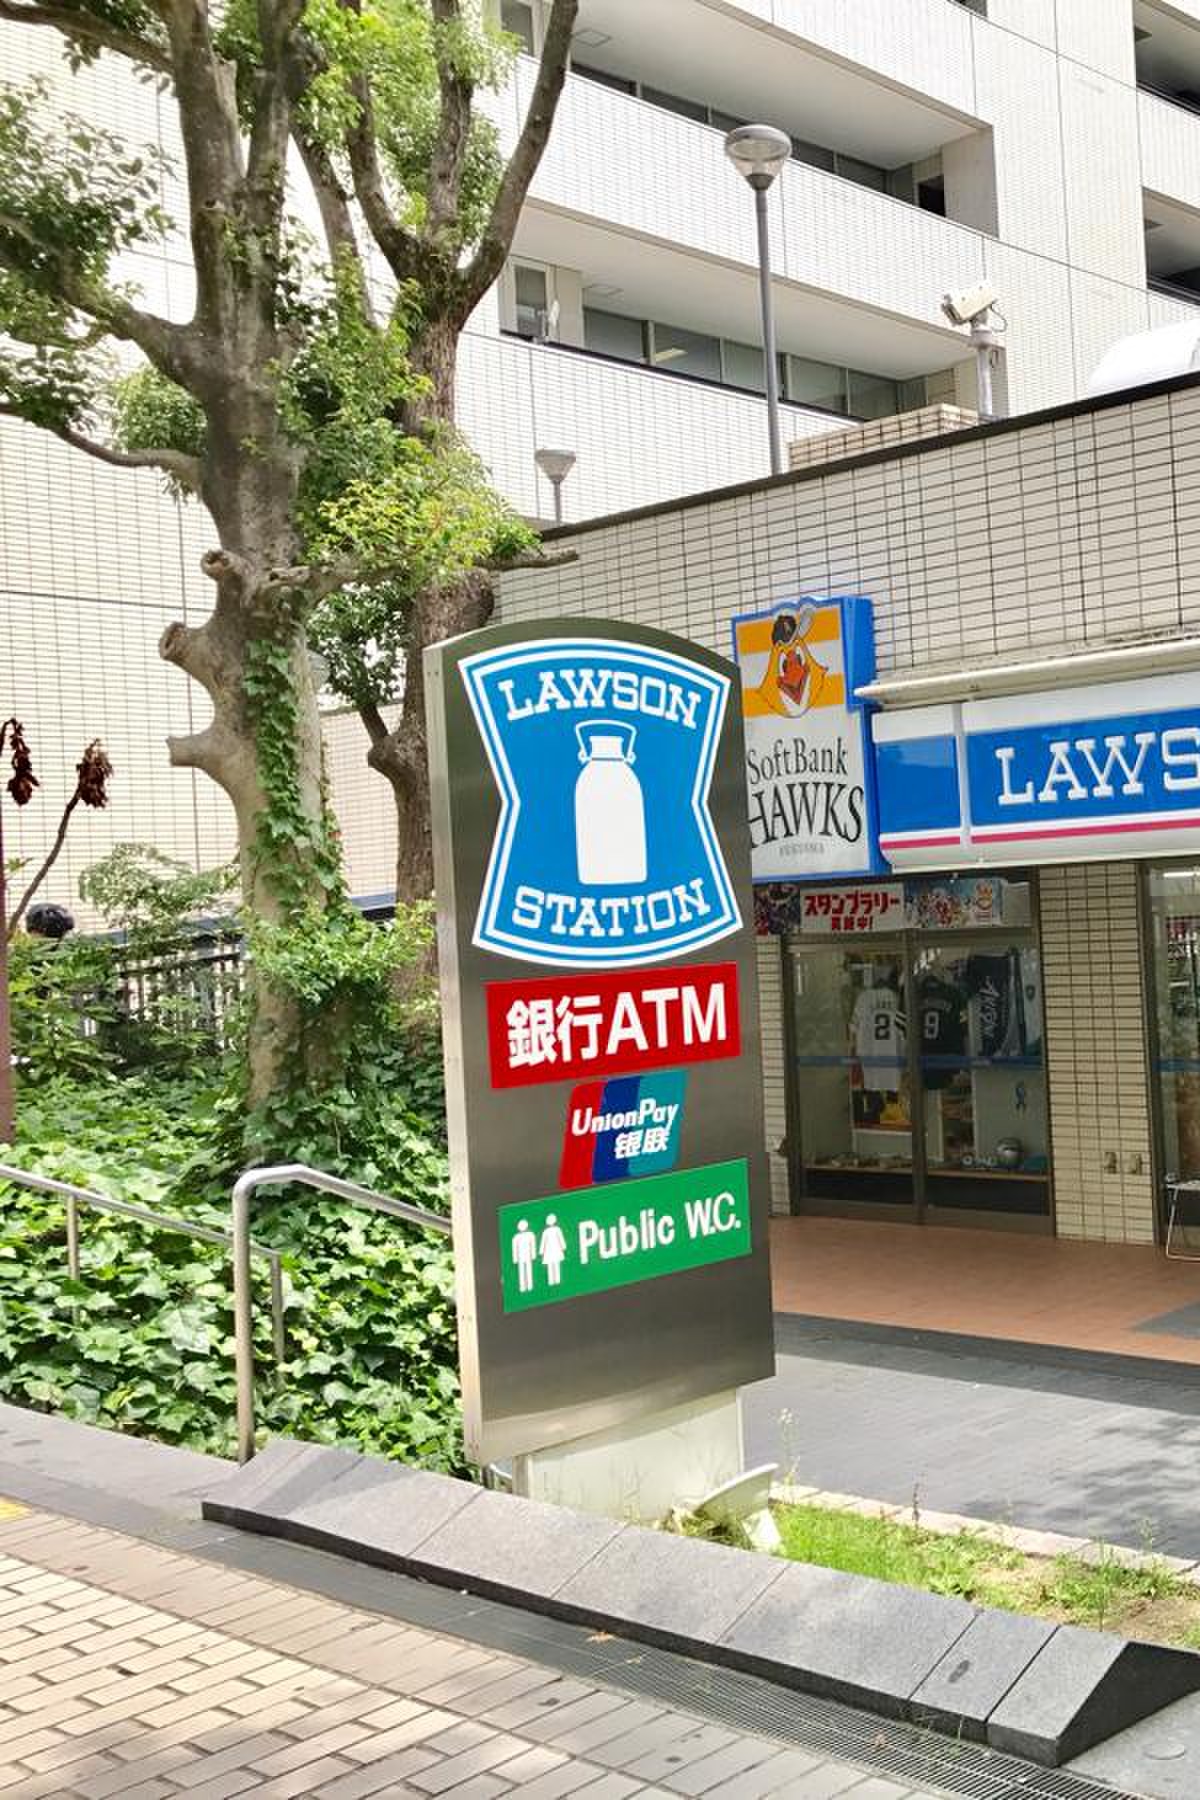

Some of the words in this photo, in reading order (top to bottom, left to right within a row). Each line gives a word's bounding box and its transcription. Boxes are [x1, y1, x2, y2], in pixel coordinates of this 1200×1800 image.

[498, 668, 702, 729] LAWSON
[747, 736, 848, 785] SoftBank
[511, 878, 711, 937] STATION
[804, 889, 899, 916] スタンプラリー
[506, 982, 728, 1068] 銀行ATM
[571, 1097, 680, 1137] UnionPay
[614, 1127, 670, 1160] 银联
[578, 1208, 676, 1265] Public
[685, 1191, 742, 1240] W.C.
